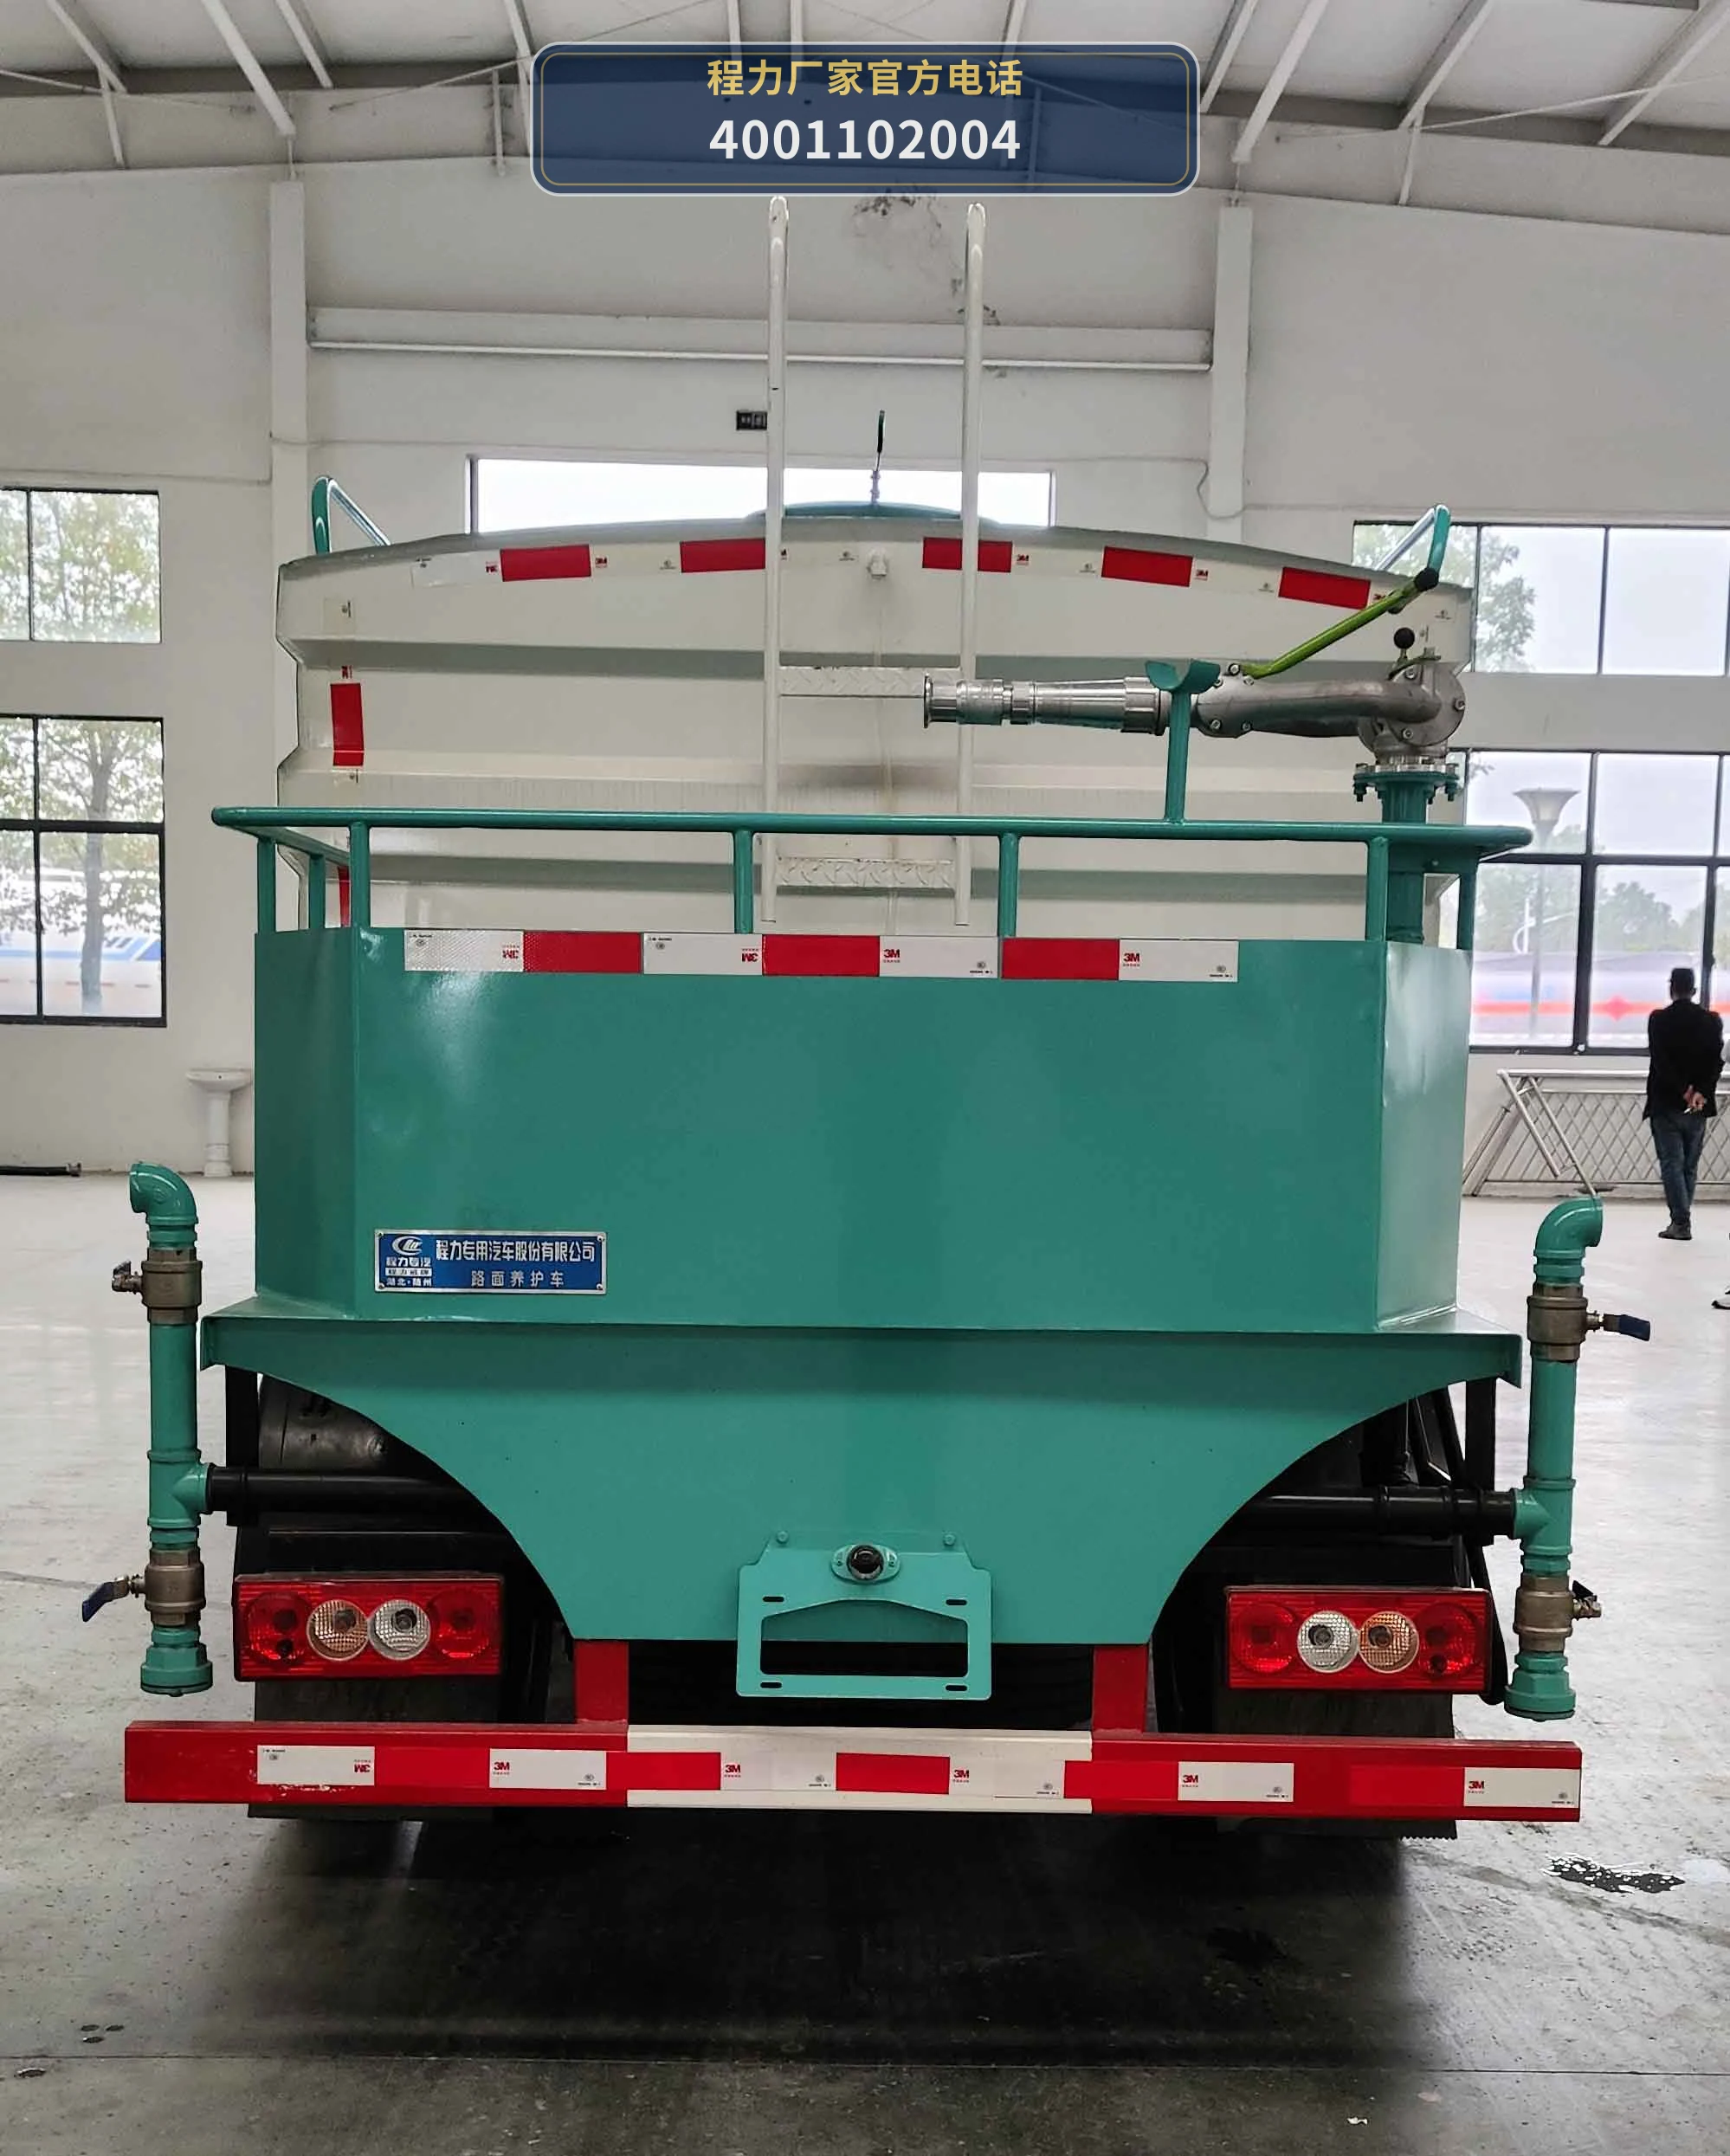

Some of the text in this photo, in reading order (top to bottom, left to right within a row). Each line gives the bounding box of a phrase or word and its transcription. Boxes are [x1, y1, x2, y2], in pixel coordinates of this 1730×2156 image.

[741, 952, 759, 963] 3M
[882, 948, 901, 959] 3M
[1122, 952, 1140, 963] 3M
[436, 1240, 594, 1262] 程力专用汽车股份有限公司
[472, 1271, 563, 1287] 路面养护车
[493, 1761, 510, 1771] 3M
[724, 1764, 741, 1773] 3M
[952, 1769, 970, 1778] 3M
[1181, 1774, 1199, 1784] 3M
[1468, 1780, 1485, 1790] 3M
